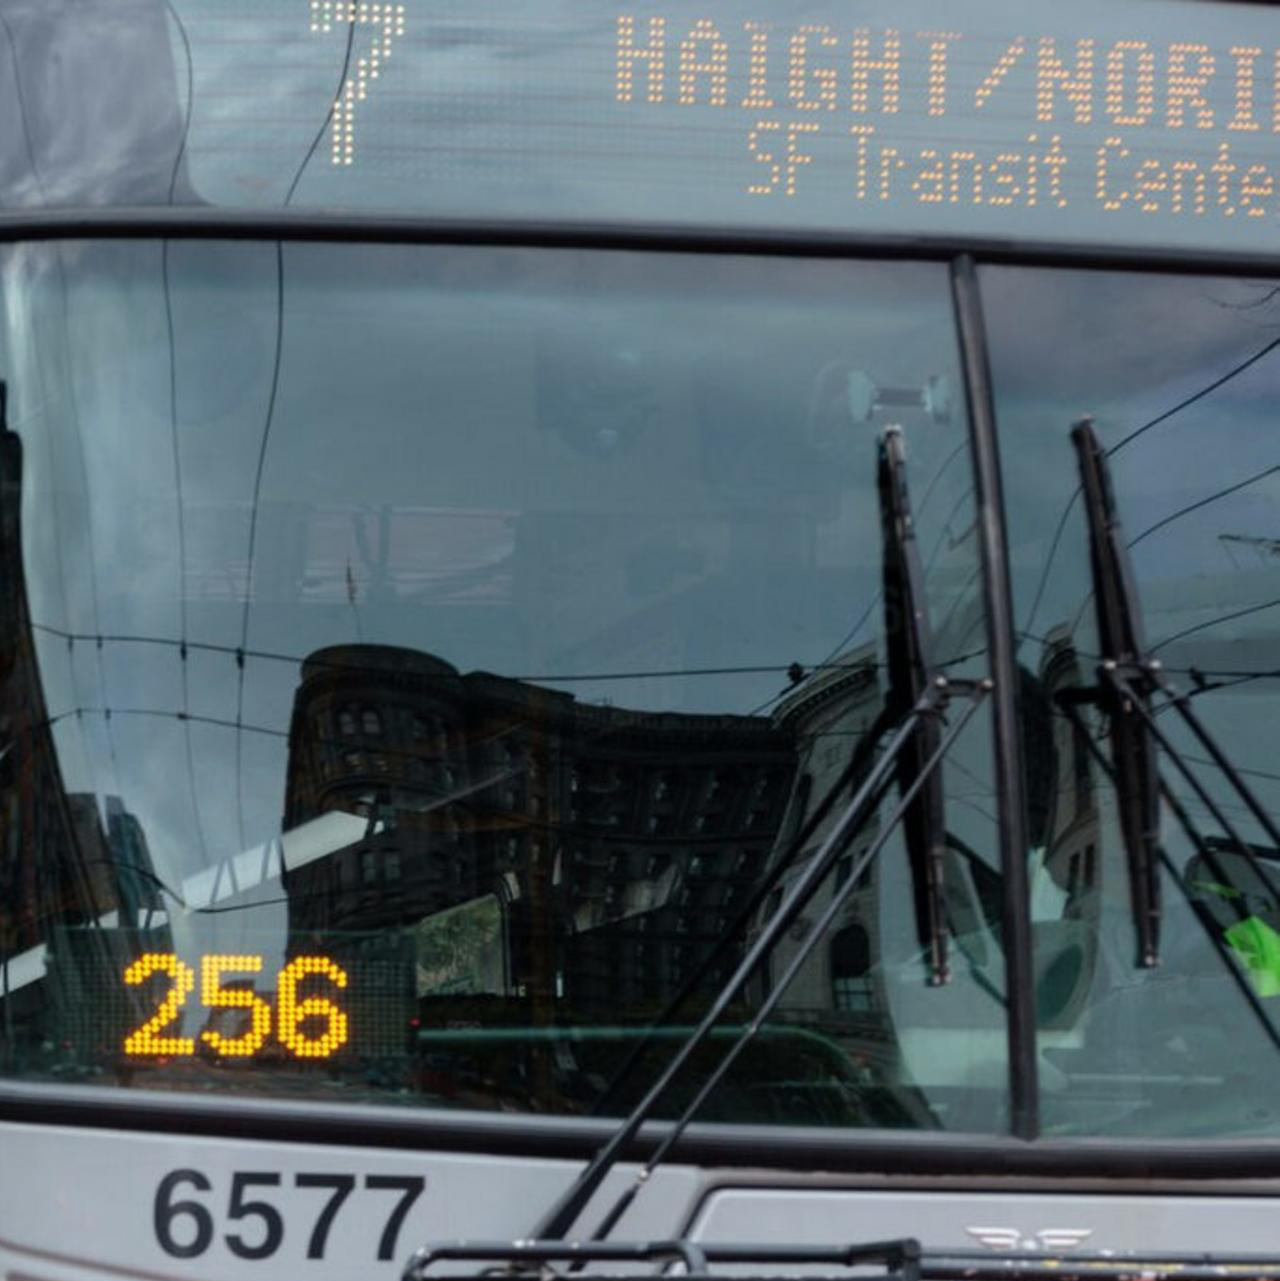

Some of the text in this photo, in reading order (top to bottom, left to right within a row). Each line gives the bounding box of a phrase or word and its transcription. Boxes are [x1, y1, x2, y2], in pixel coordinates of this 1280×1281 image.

[310, 1, 404, 167] 7
[617, 15, 1280, 132] HAIGHT/NORI
[748, 121, 819, 195] SF
[851, 126, 1067, 207] Transit
[124, 952, 348, 1057] 256
[153, 1168, 426, 1261] 6577
